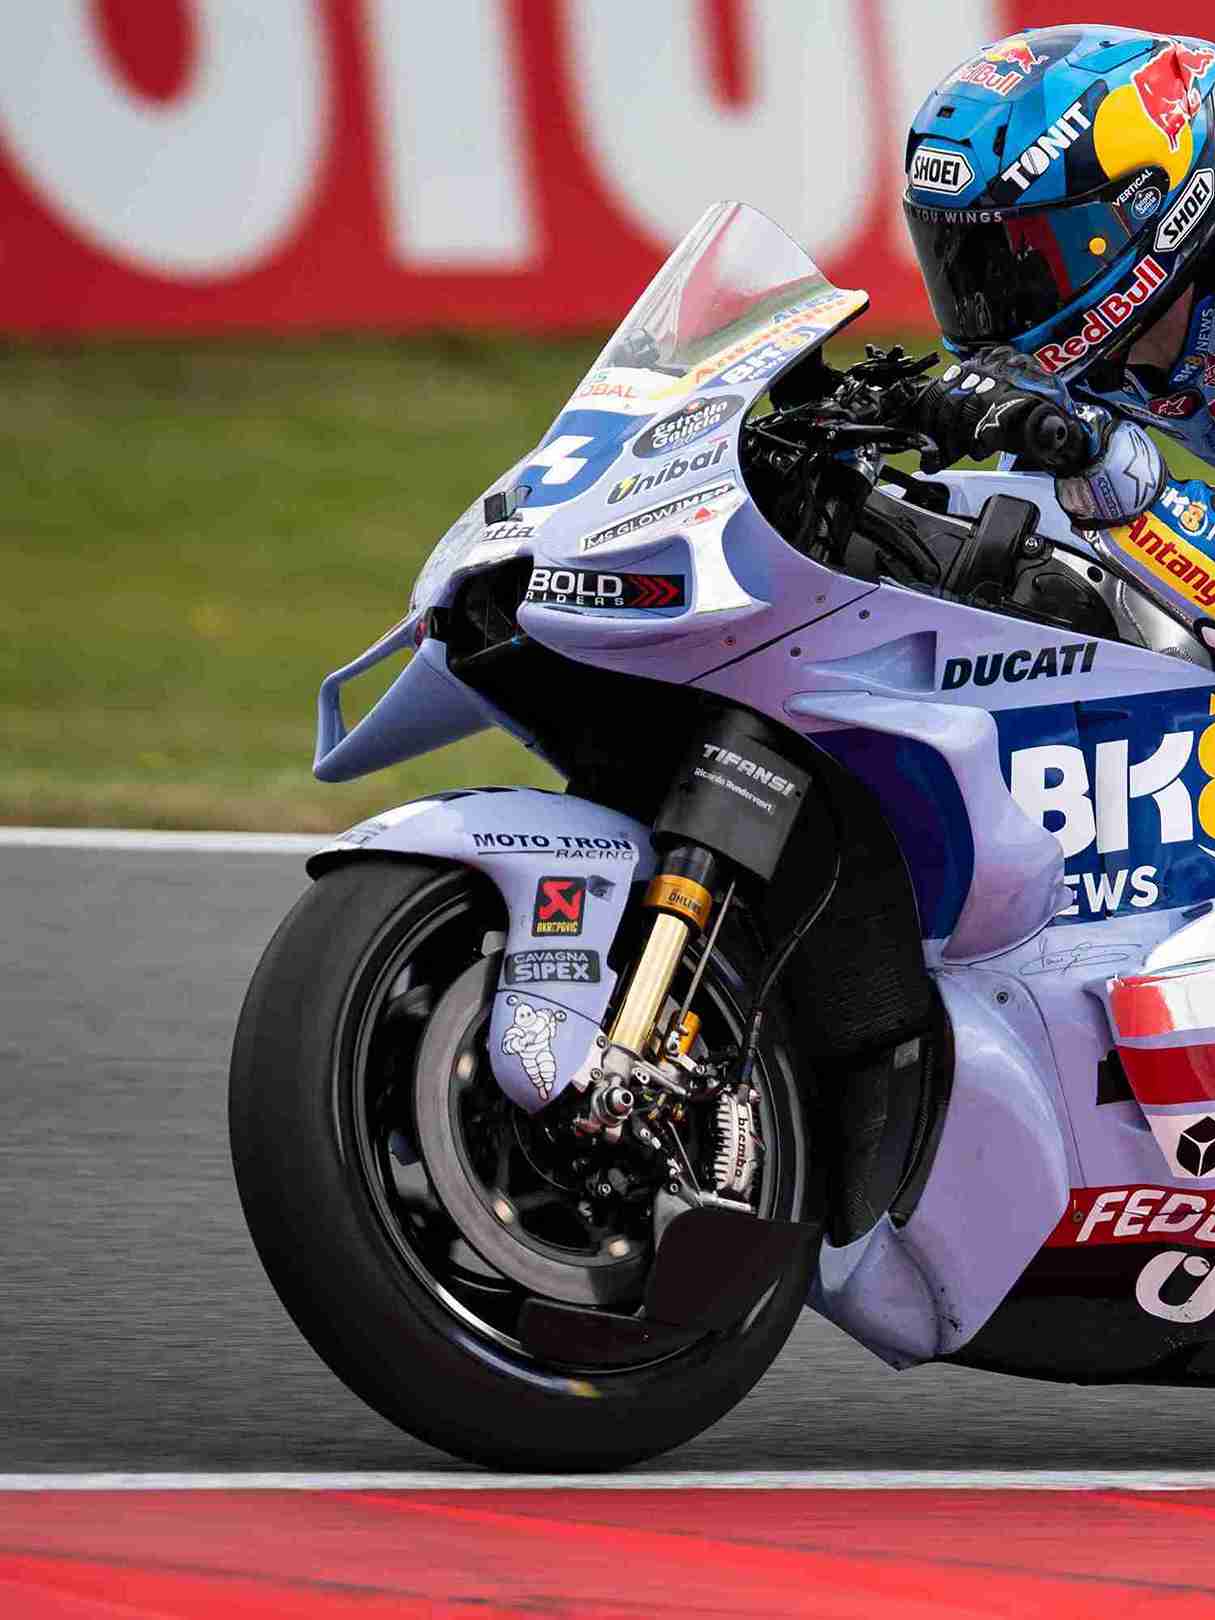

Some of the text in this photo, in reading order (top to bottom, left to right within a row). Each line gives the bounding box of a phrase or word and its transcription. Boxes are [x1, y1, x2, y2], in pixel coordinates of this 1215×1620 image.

[1002, 102, 1094, 190] TONIT
[914, 156, 960, 186] SHOEI
[1112, 168, 1153, 208] VERTICAL
[945, 211, 1003, 224] WINGS
[1163, 178, 1210, 243] SHOEI
[1033, 313, 1111, 373] Red
[1099, 255, 1167, 327] Bull
[652, 401, 728, 437] Estrella
[652, 412, 721, 449] Galicia
[607, 440, 729, 504] Unibat
[1160, 487, 1207, 535] K8
[525, 591, 625, 606] RIDERS
[528, 568, 623, 597] BOLD
[941, 642, 1098, 690] DUCATI
[703, 743, 796, 797] TIFANSI
[472, 833, 633, 850] MOTO TRON
[555, 849, 634, 861] RACING
[1058, 865, 1160, 918] EWS
[514, 951, 589, 963] CAVAGNA
[515, 962, 590, 981] SIPEX
